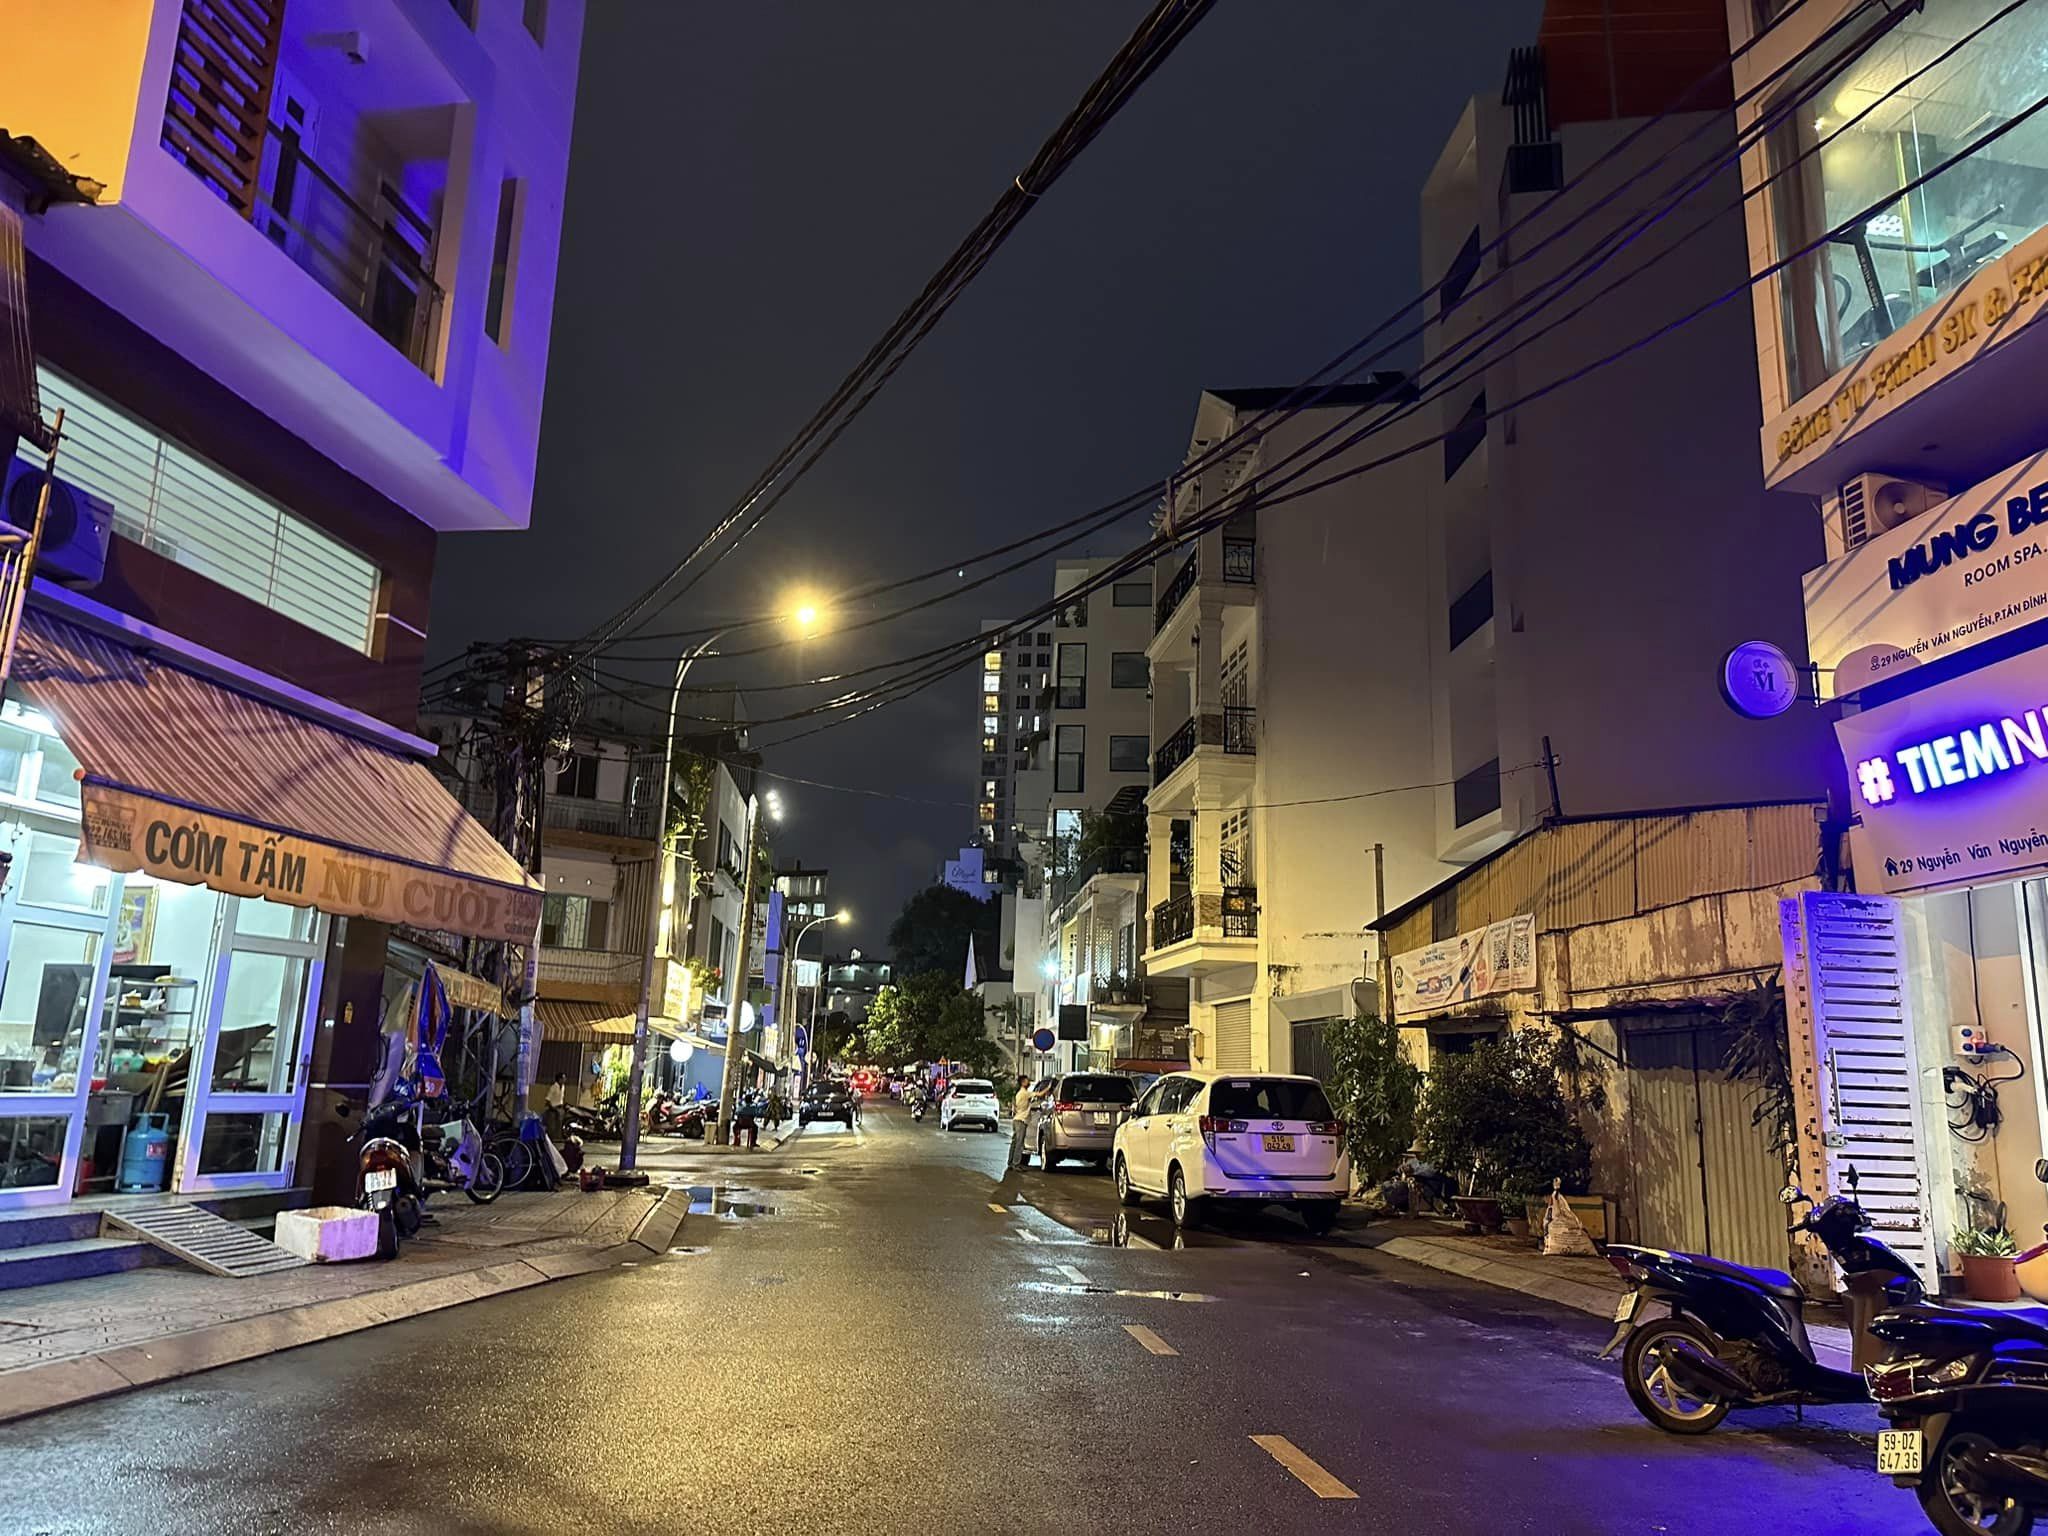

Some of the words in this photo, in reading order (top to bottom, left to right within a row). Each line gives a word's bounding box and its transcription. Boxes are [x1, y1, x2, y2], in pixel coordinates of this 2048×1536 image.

[1941, 303, 1977, 353] SK
[1888, 514, 1999, 590] MUNG
[1964, 555, 2010, 587] ROOM
[1881, 655, 1891, 667] 29
[146, 820, 227, 876] CƠM
[239, 835, 307, 894] TẤM
[1900, 860, 1913, 874] 29
[1917, 847, 1961, 872] Nguyễn
[1967, 843, 1992, 860] Văn
[1884, 1432, 1915, 1450] 59-D2
[1880, 1451, 1919, 1470] 647.36
